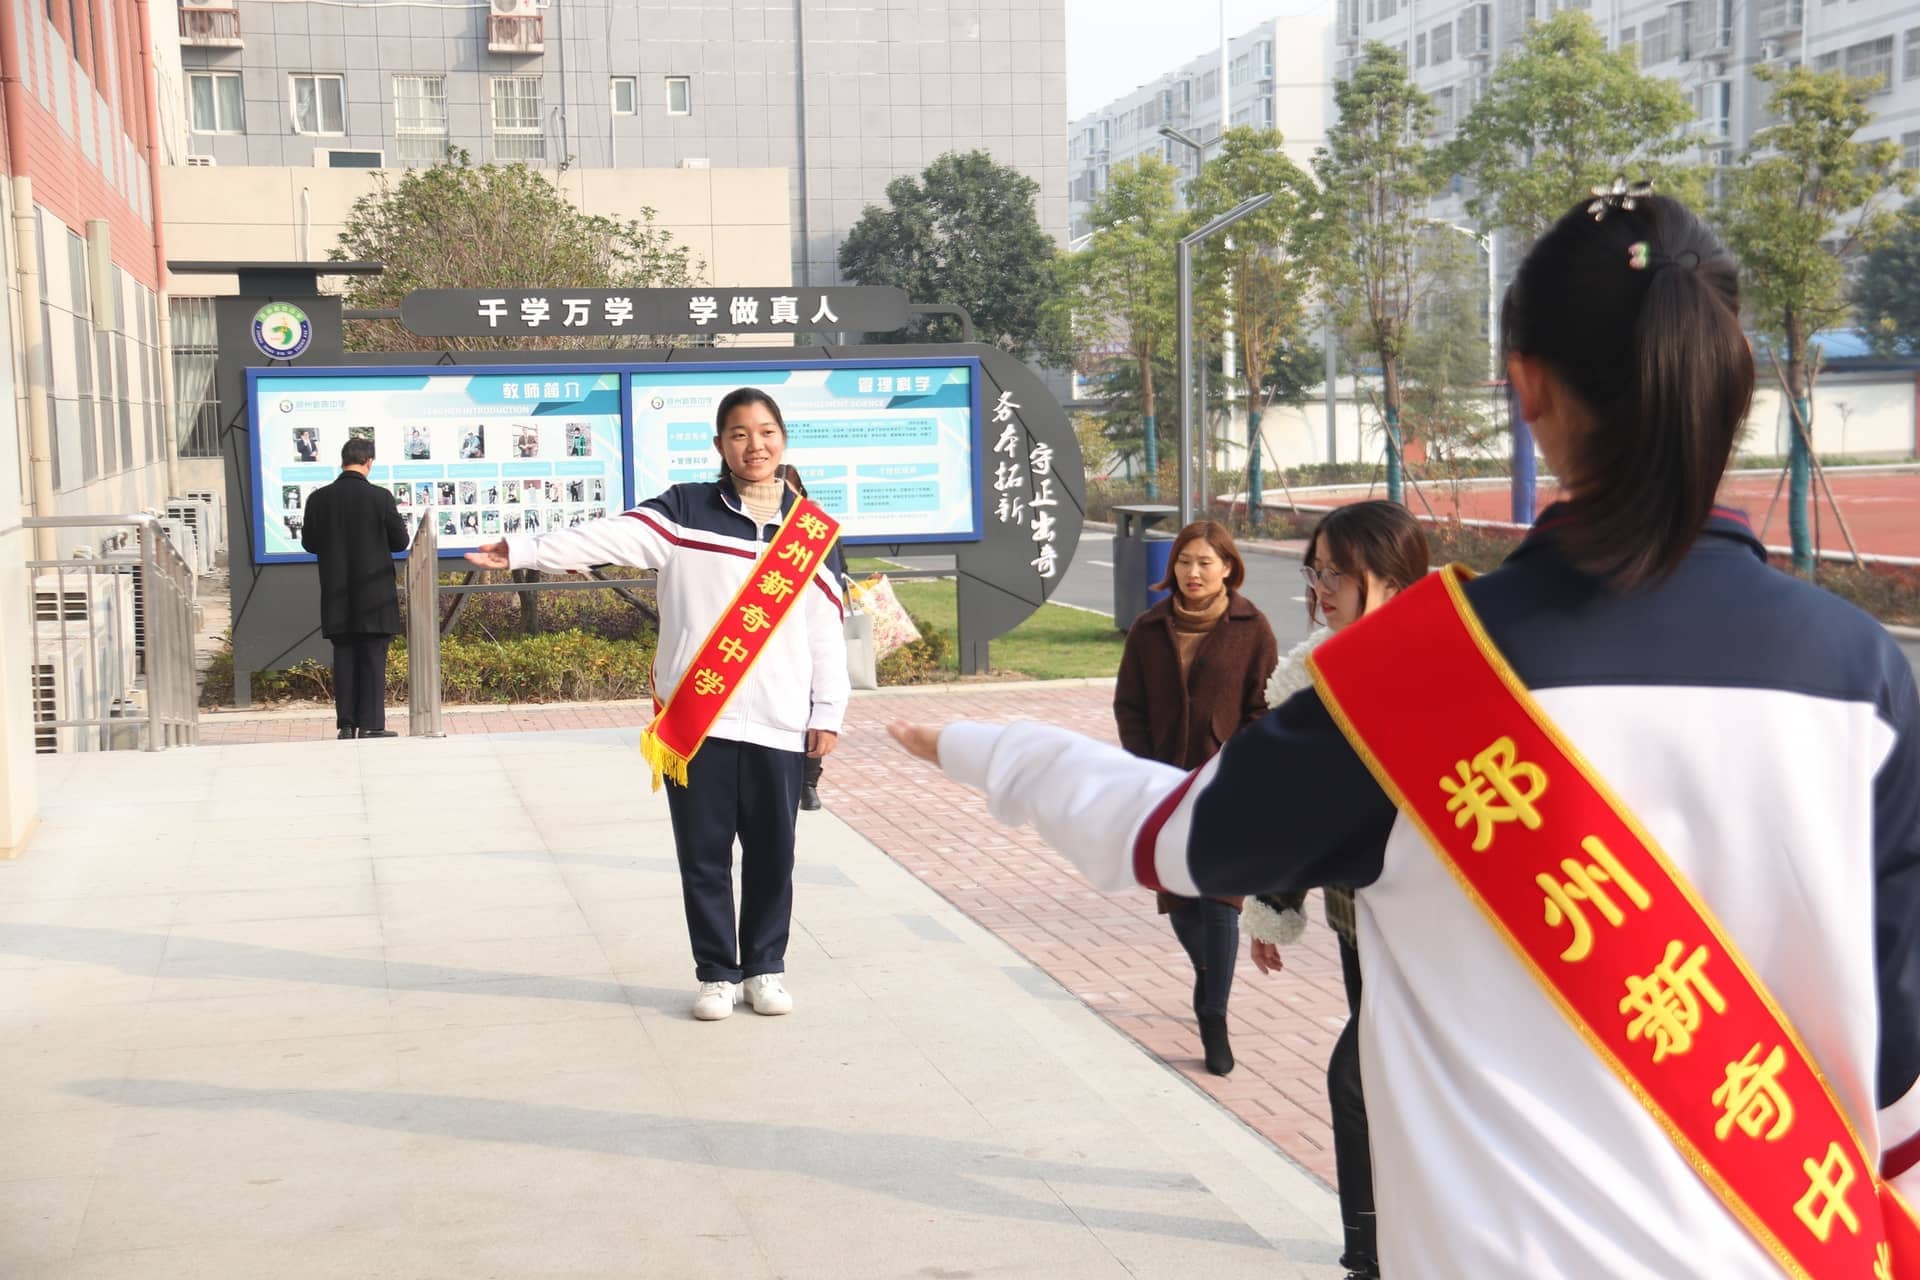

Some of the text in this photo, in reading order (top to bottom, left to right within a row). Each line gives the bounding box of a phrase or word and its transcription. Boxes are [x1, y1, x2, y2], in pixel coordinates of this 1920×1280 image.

[478, 294, 839, 328] 千学万学 学做真人
[502, 382, 580, 399] 教师简介
[858, 376, 931, 393] 管理科学
[991, 390, 1025, 525] 务本拓新
[1028, 442, 1059, 578] 守正出奇
[694, 511, 829, 697] 郑州新奇中学
[1438, 735, 1893, 1280] 郑州新奇中
